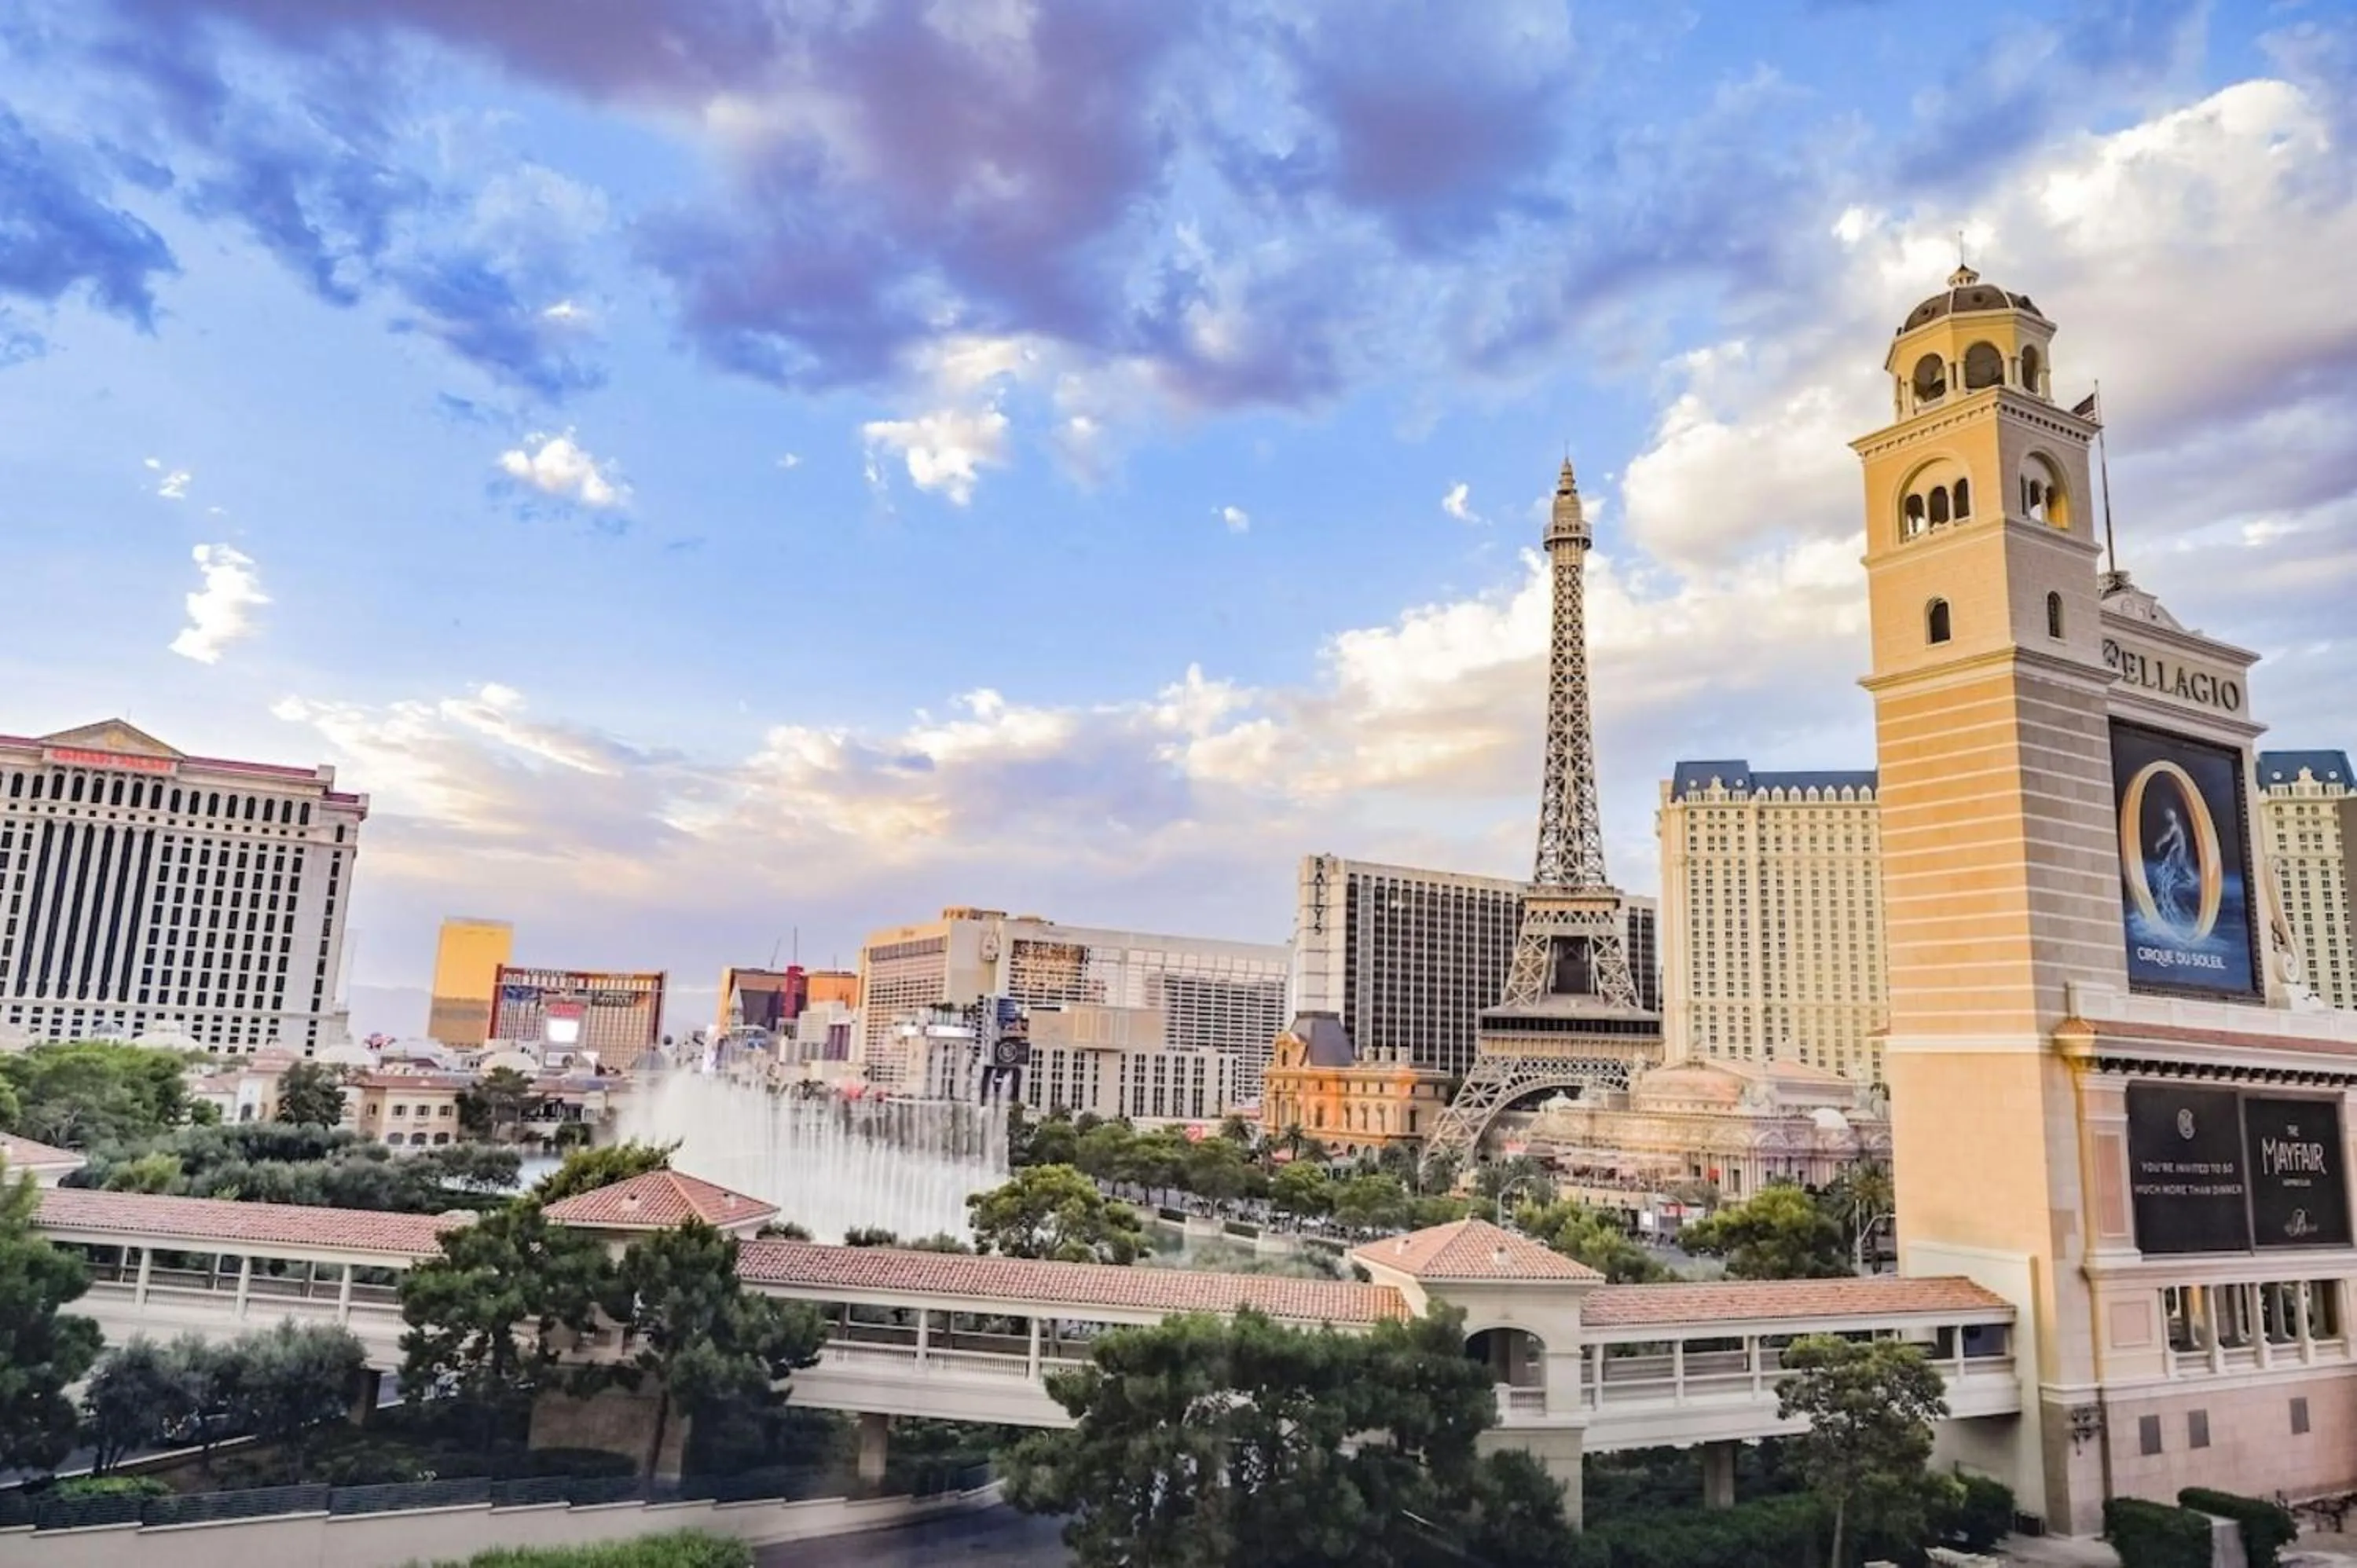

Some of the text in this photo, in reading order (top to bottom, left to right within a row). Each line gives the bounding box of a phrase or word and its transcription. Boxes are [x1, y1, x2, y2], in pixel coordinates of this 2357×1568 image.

[2137, 947, 2227, 969] CIRQUE DU SOLEIL
[2262, 1138, 2327, 1175] MAYFAIR
[2176, 1163, 2210, 1175] INVITED
[2135, 1183, 2161, 1195] MUCH
[2162, 1183, 2187, 1195] MORE
[2188, 1183, 2211, 1195] THAN
